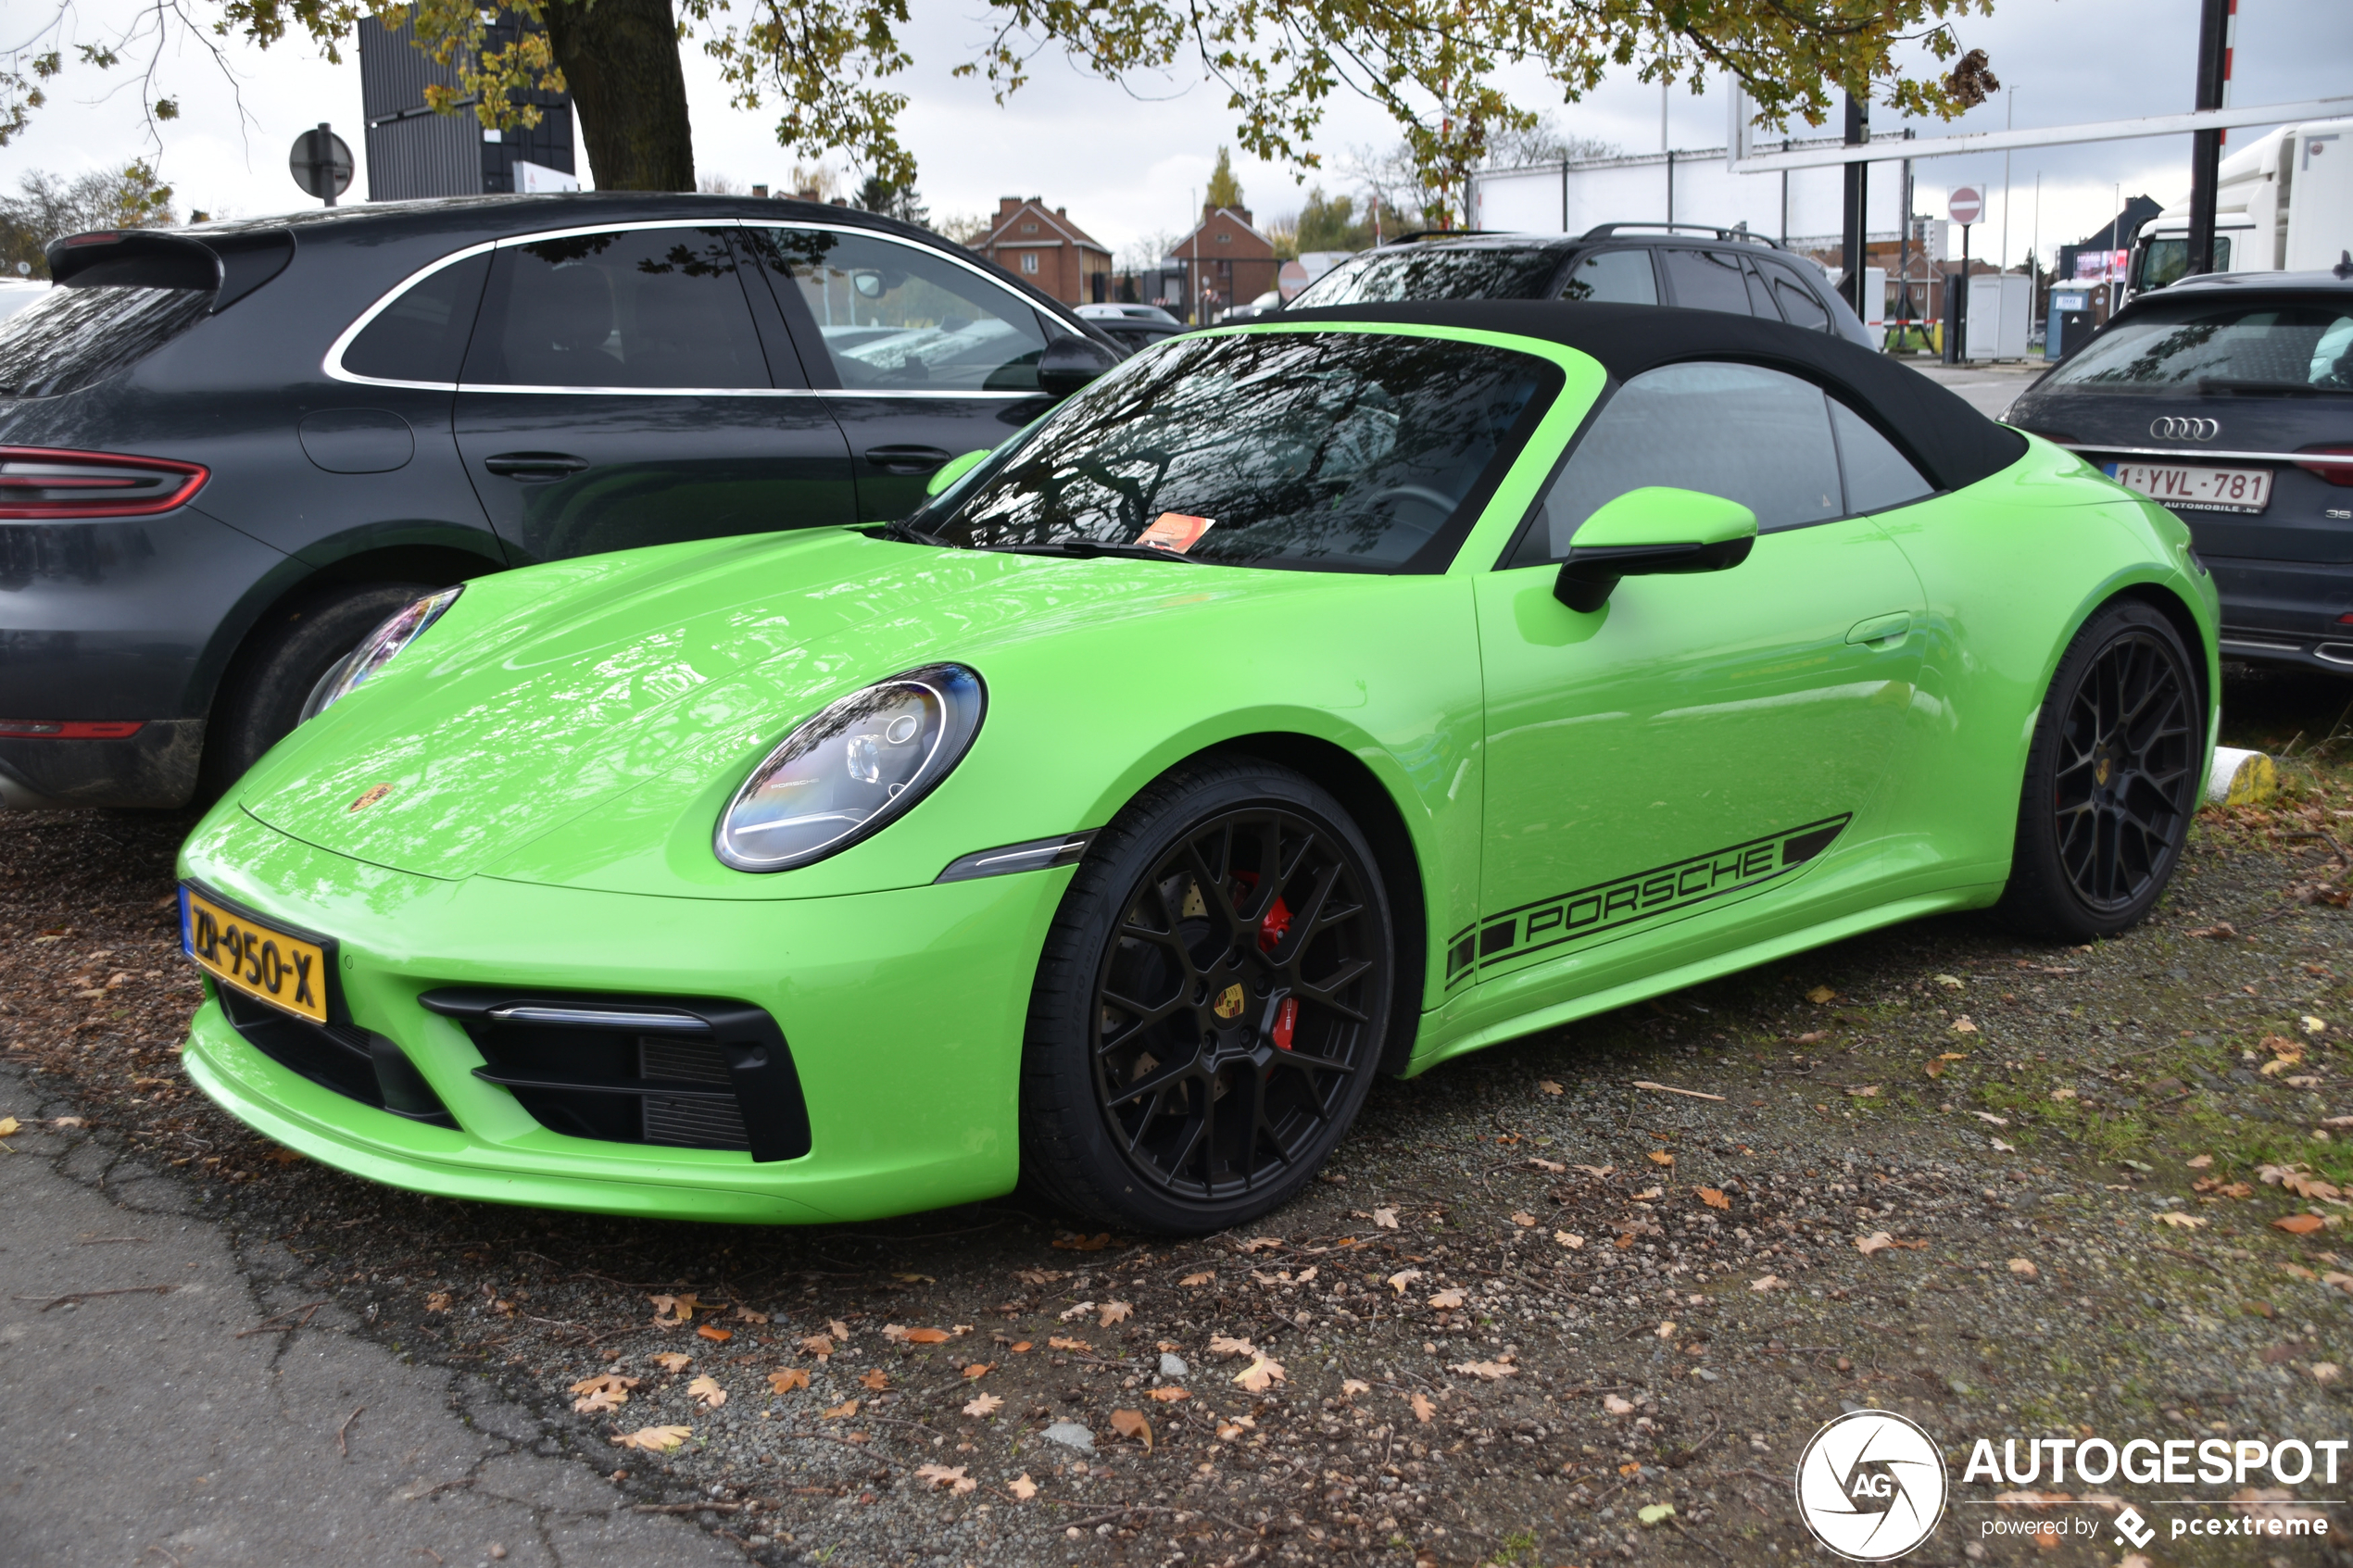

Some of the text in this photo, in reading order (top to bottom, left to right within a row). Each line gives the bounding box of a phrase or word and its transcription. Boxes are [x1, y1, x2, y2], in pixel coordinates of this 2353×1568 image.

[2163, 501, 2240, 512] AUTOMOBILE
[2325, 509, 2351, 519] 35
[771, 778, 820, 789] PORSCHE
[1526, 843, 1774, 942] PORSCHE
[193, 904, 316, 1009] ZR-950-X
